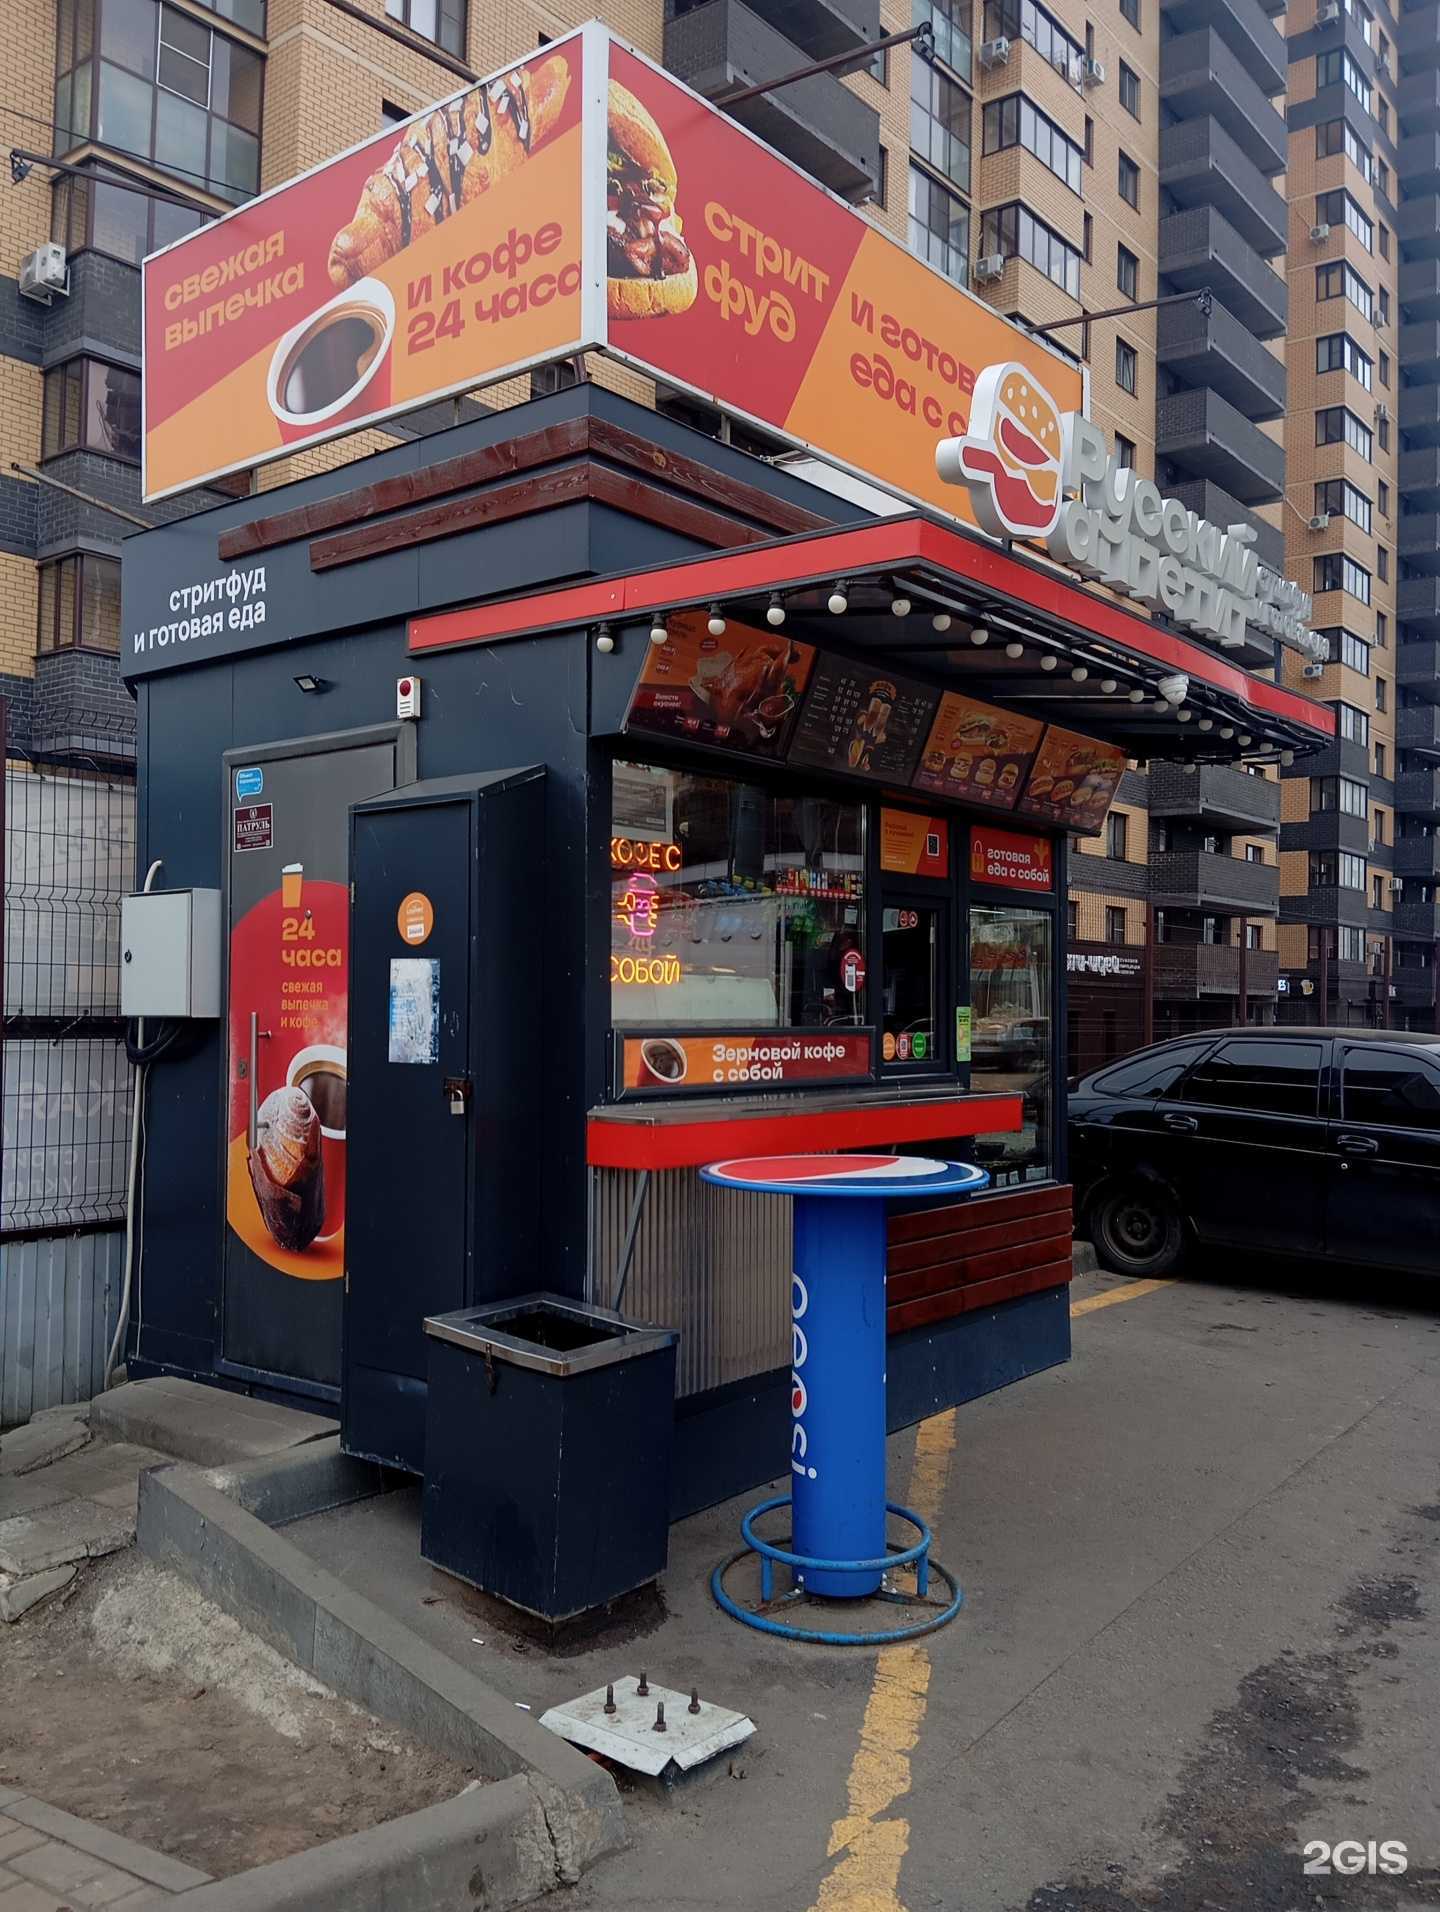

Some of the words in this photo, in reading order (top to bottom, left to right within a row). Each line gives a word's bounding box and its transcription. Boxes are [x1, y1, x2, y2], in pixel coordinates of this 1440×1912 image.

[408, 274, 433, 309] и
[442, 222, 562, 296] кофе
[704, 202, 829, 304] стрит
[164, 231, 285, 311] свежая
[164, 262, 304, 351] выпечка
[704, 260, 796, 344] фуд
[408, 308, 465, 356] 24
[850, 352, 916, 416] еда
[922, 396, 943, 428] с
[170, 566, 266, 614] стритфуд
[134, 633, 145, 653] и
[150, 610, 223, 648] готовая
[228, 600, 266, 631] еда
[237, 820, 270, 833] ПАТРУЛЬ
[665, 845, 681, 871] С
[987, 848, 1031, 865] готовая
[987, 862, 1008, 877] еда
[1009, 868, 1017, 878] с
[1017, 868, 1049, 883] собой
[282, 917, 316, 941] 24
[282, 949, 342, 967] часа
[282, 981, 323, 993] свежая
[281, 999, 329, 1010] выпечка
[712, 1042, 801, 1063] Зерновой
[804, 1042, 846, 1062] кофе
[712, 1069, 724, 1082] с
[728, 1061, 784, 1082] собой
